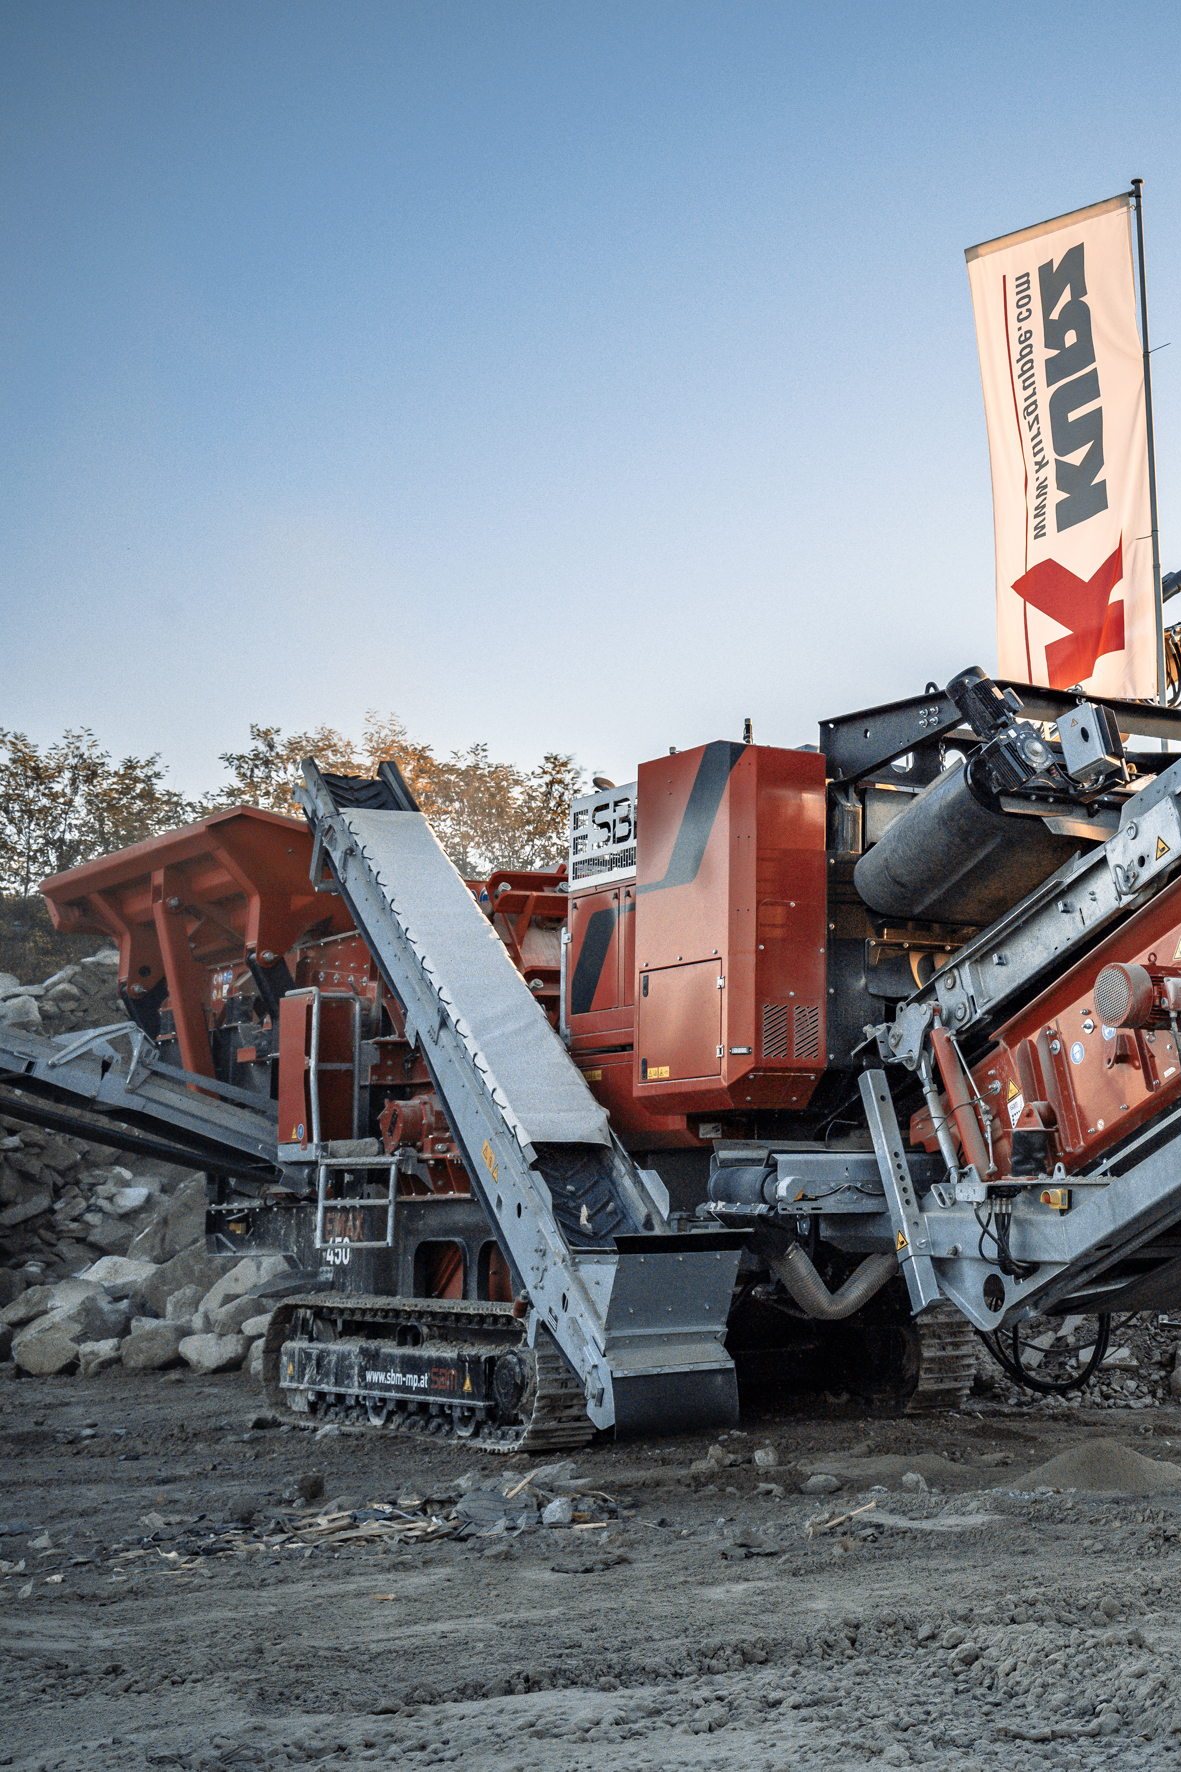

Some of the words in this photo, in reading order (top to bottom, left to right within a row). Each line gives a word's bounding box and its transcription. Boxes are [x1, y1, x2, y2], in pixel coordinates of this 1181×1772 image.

[591, 797, 637, 851] SB
[325, 1210, 364, 1241] EMAX
[326, 1236, 350, 1265] 450
[365, 1368, 429, 1391] www.sbm-mp.at
[430, 1367, 457, 1391] SBM
